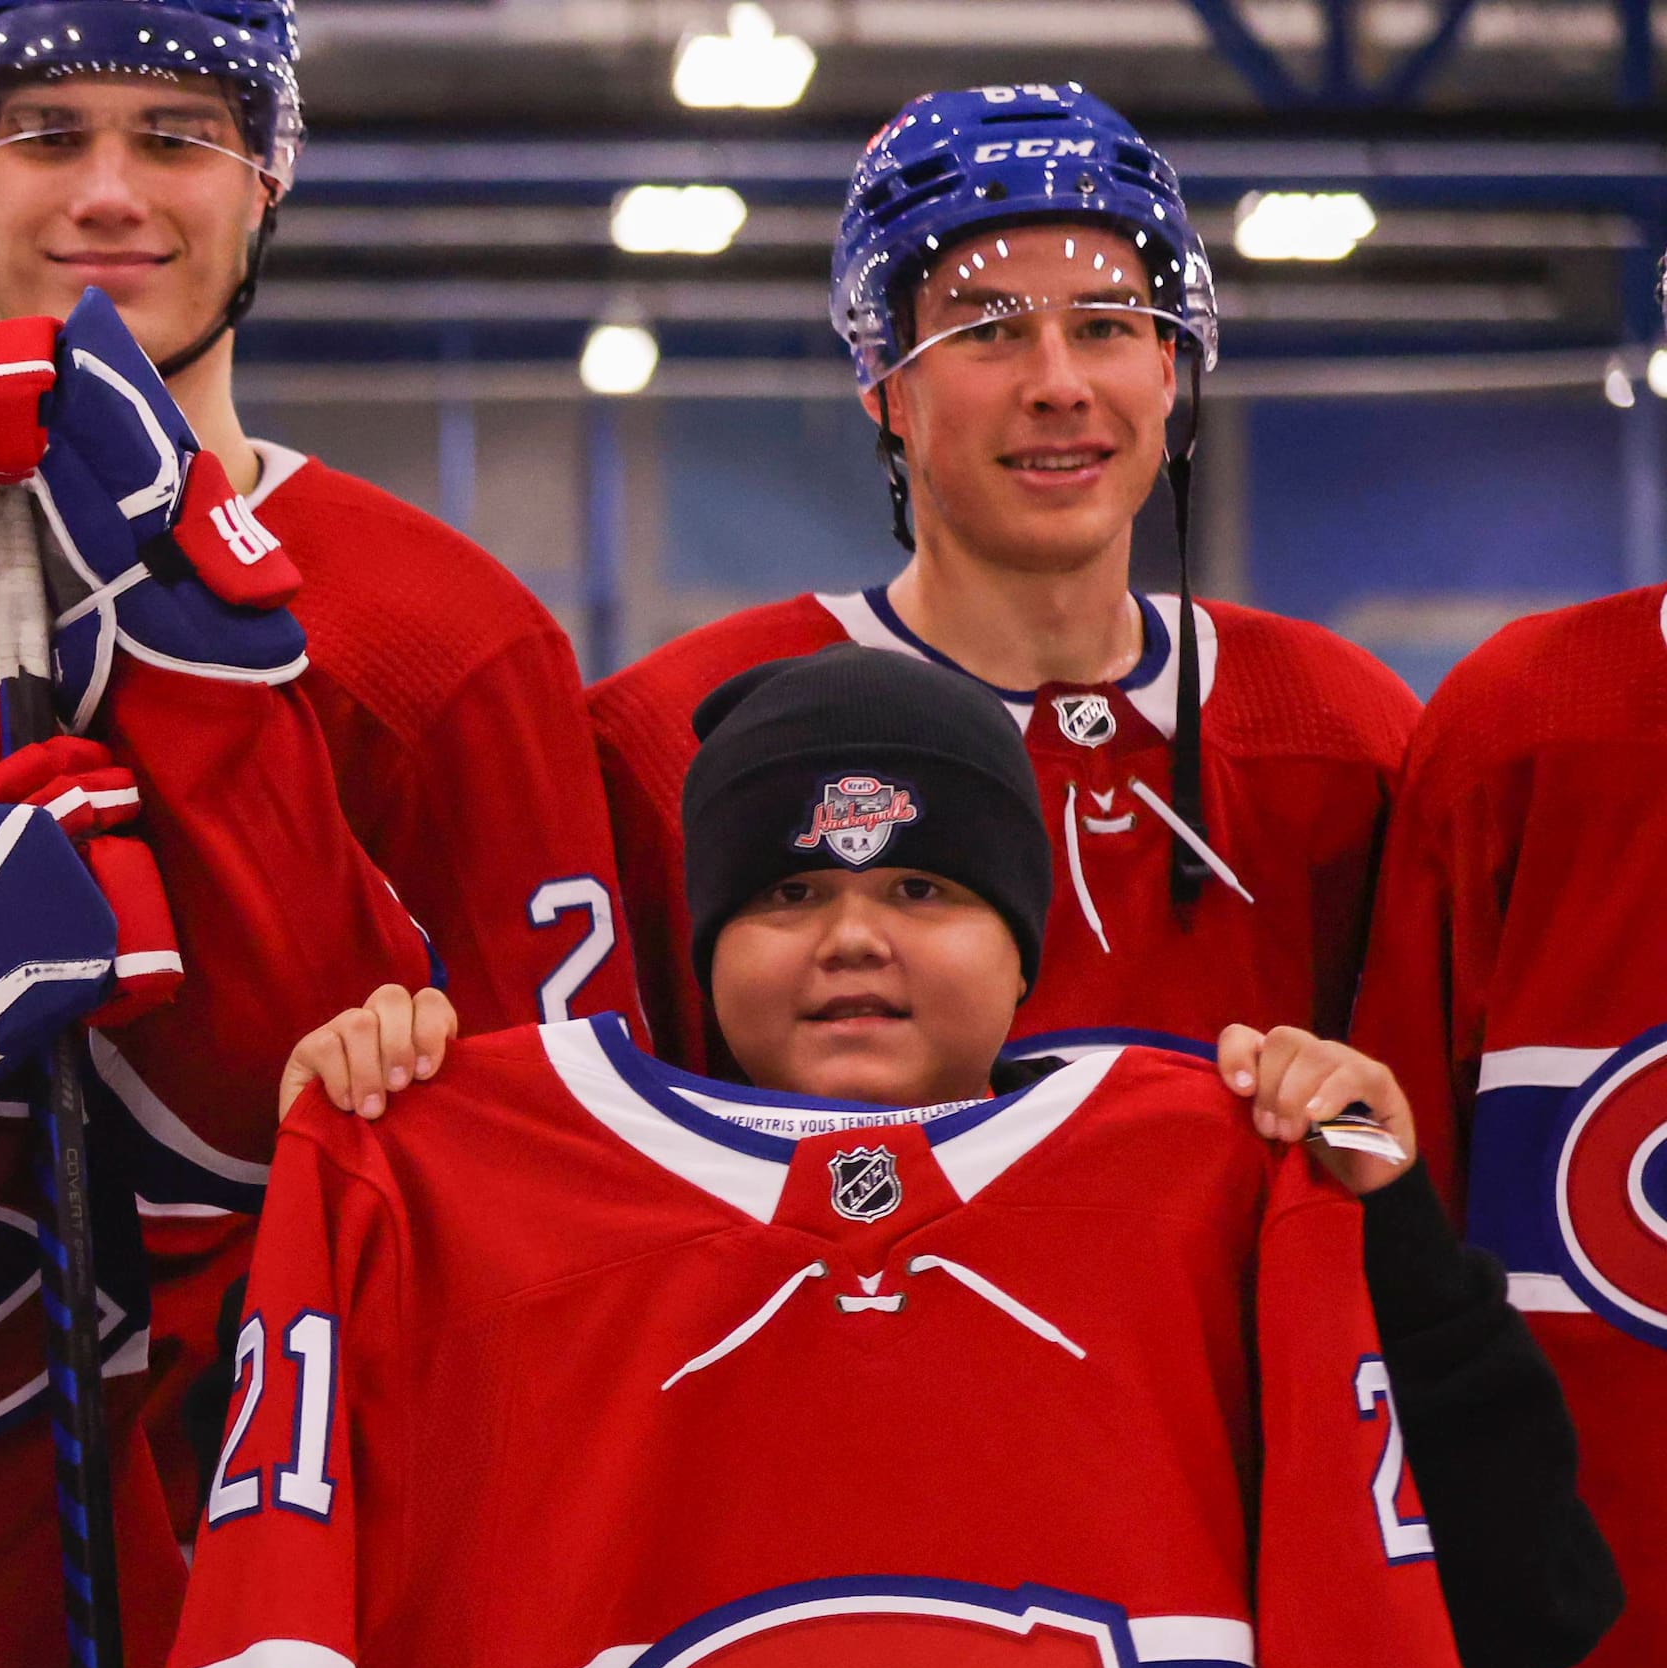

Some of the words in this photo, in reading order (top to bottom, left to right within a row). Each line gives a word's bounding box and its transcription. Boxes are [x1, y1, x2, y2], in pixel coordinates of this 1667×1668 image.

[974, 138, 1095, 164] CCM
[847, 782, 872, 791] Kraft
[800, 1118, 835, 1132] VOUS
[841, 1113, 898, 1130] TENDENT
[902, 1111, 917, 1123] LE
[206, 1308, 339, 1530] 21
